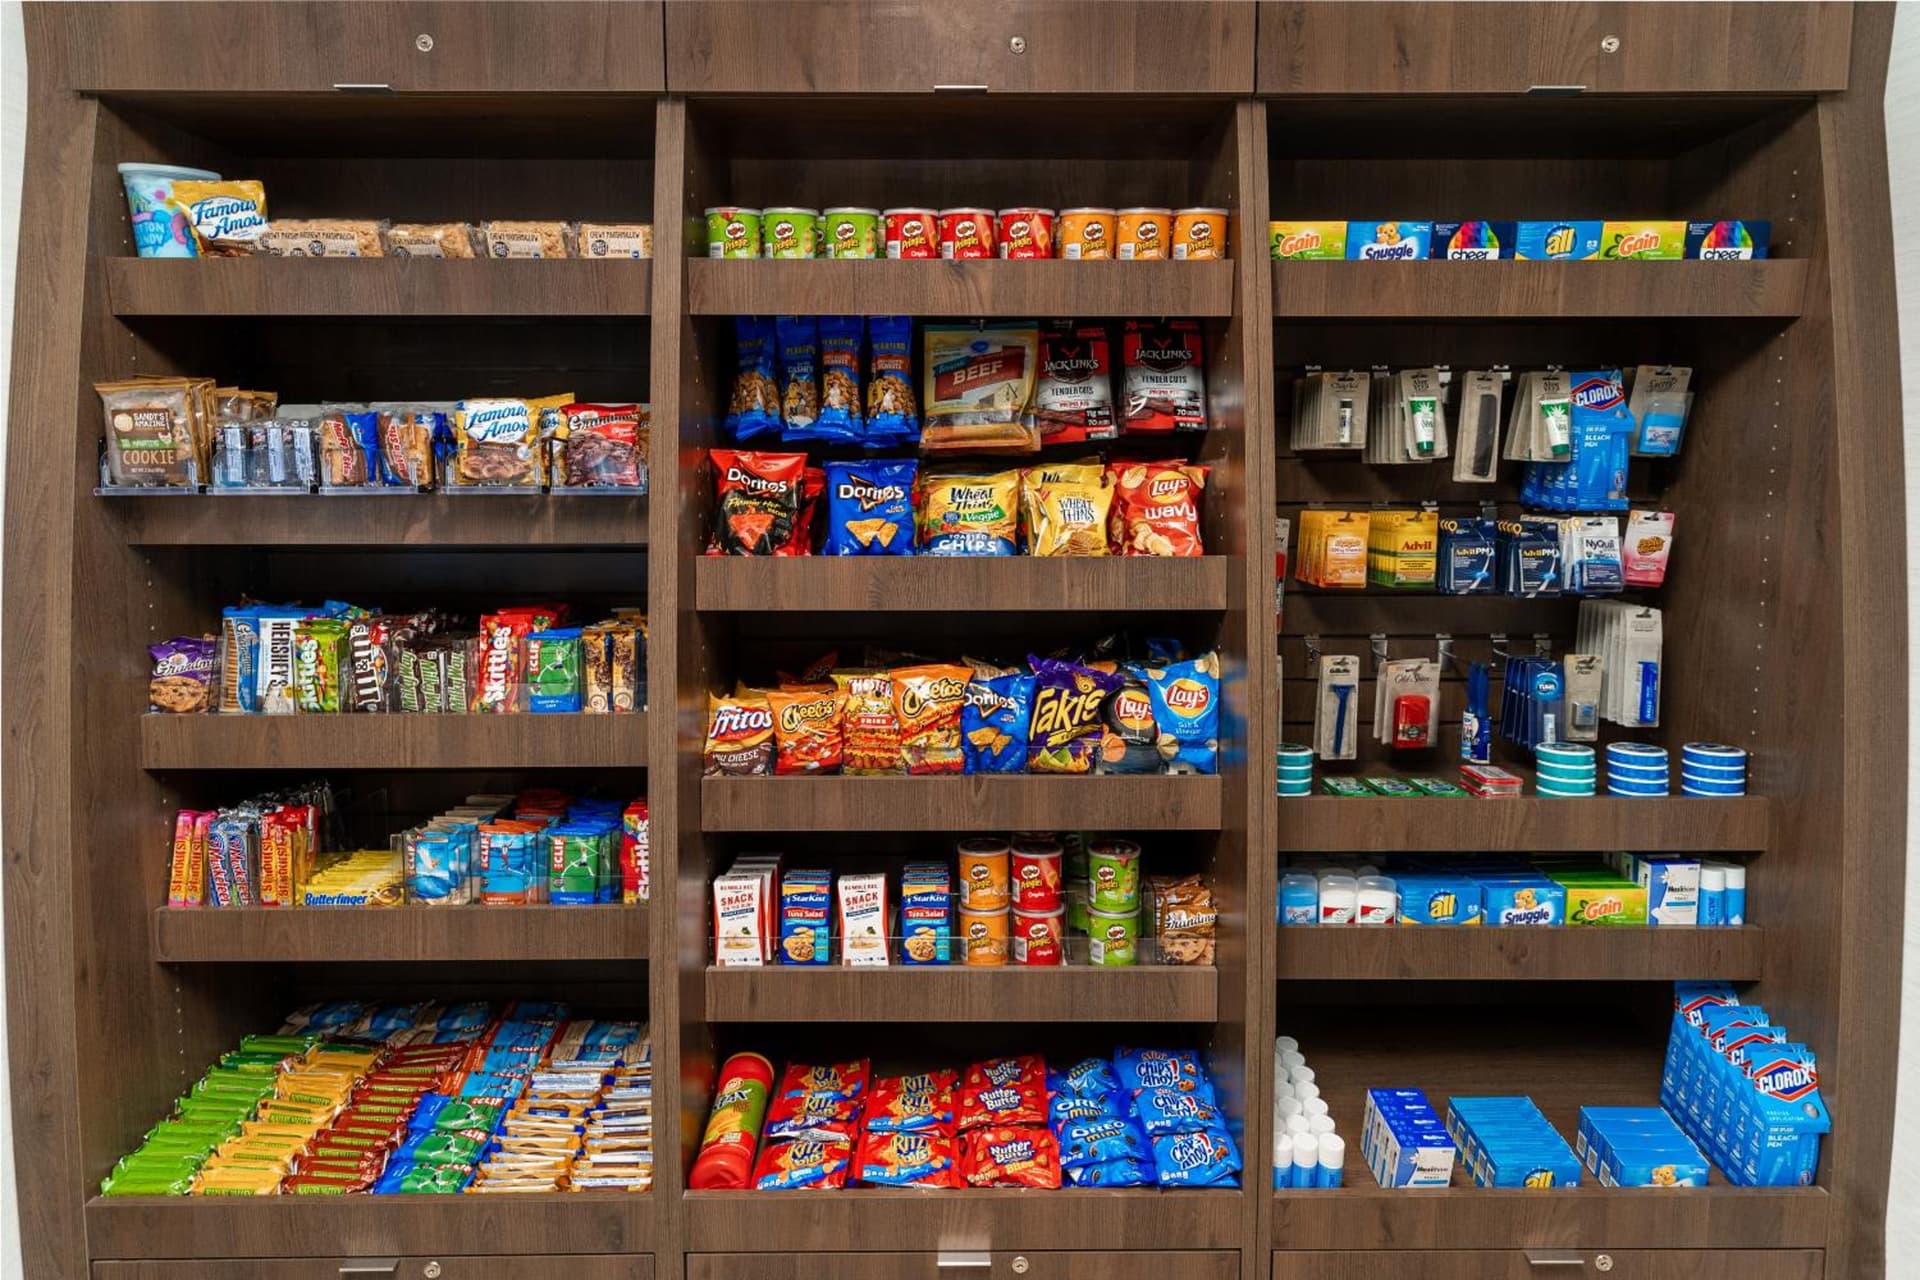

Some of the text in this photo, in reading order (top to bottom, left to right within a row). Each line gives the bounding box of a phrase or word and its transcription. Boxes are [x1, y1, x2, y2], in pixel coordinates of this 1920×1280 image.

[191, 200, 257, 226] Famous
[1280, 233, 1321, 256] Gain
[1546, 228, 1575, 254] all
[1619, 234, 1659, 257] Gain
[953, 361, 1003, 385] BEEF
[1576, 384, 1619, 406] CLOROX
[480, 421, 528, 441] Amos
[123, 450, 175, 465] COOKIE
[727, 468, 788, 493] Doritos
[839, 484, 905, 500] Doritos
[1145, 502, 1198, 522] wavy
[940, 540, 997, 553] CHIPS
[1402, 541, 1433, 551] Advil
[1586, 539, 1615, 551] NyQuil
[484, 625, 512, 705] Skittles
[1168, 685, 1207, 710] Lay's
[782, 700, 837, 733] Cheetos
[1029, 688, 1106, 741] Takis
[304, 893, 368, 905] Butterfinger
[721, 894, 754, 906] SNACK
[791, 894, 826, 903] StarKist
[845, 892, 878, 906] SNACK
[912, 894, 948, 903] StarKist
[1429, 894, 1456, 919] all
[804, 910, 824, 918] Salad
[925, 910, 945, 918] Salad
[1504, 908, 1550, 925] Snuggle
[1584, 899, 1622, 920] Gain
[901, 1076, 934, 1091] RITZ
[1759, 1067, 1813, 1094] CLOROX
[980, 1089, 1016, 1103] Nutter
[986, 1096, 1021, 1111] Butter
[1071, 1120, 1125, 1139] OREO
[1086, 1130, 1120, 1143] mini
[788, 1141, 825, 1157] RITZ
[892, 1136, 929, 1153] RITZ
[989, 1142, 1031, 1157] Nutter
